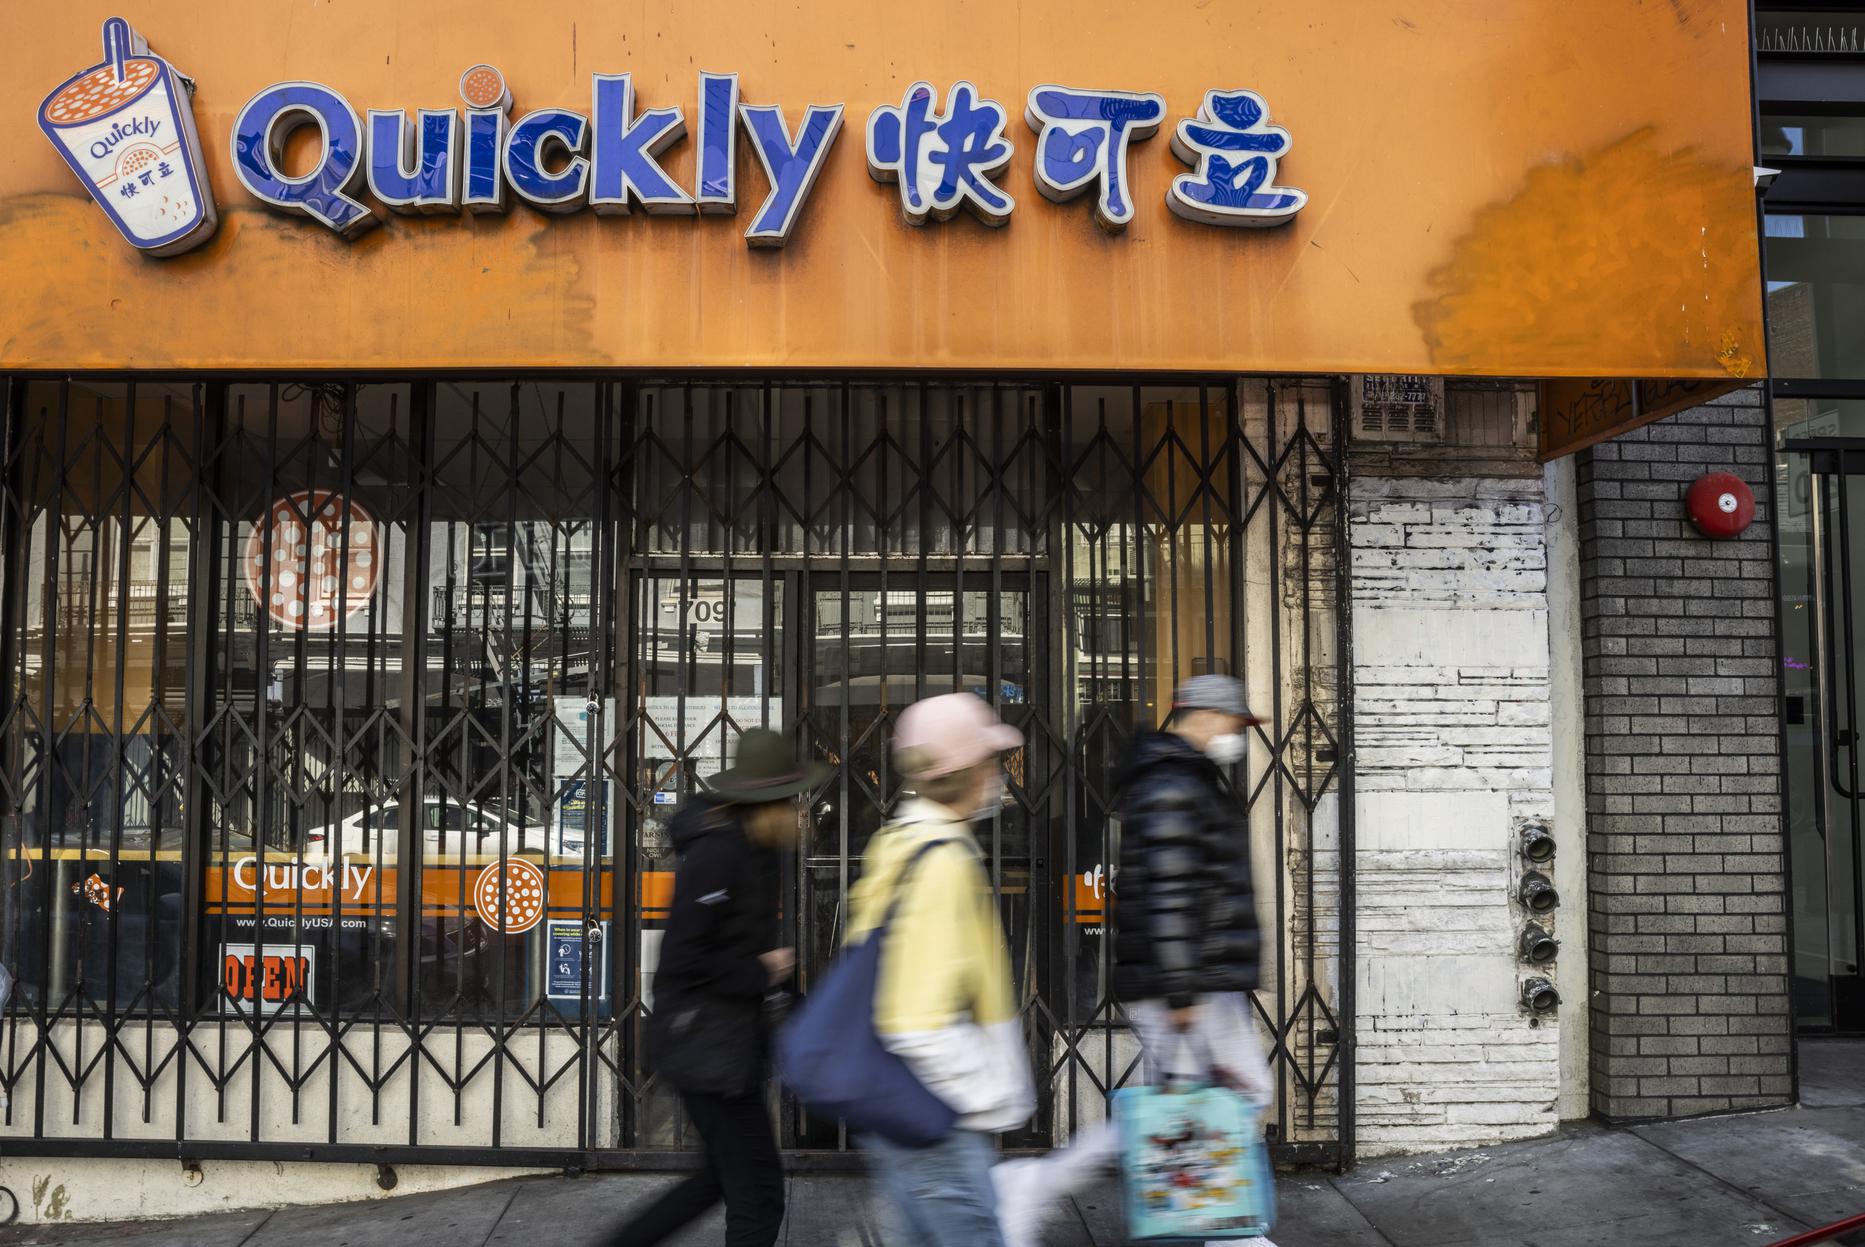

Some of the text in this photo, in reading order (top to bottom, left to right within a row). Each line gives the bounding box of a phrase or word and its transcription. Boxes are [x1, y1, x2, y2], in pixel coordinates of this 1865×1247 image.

[90, 116, 161, 159] Quickly
[230, 64, 845, 245] Quickly
[866, 80, 1308, 228] 快可立
[120, 161, 175, 199] 快可立
[233, 856, 373, 900] Quickly
